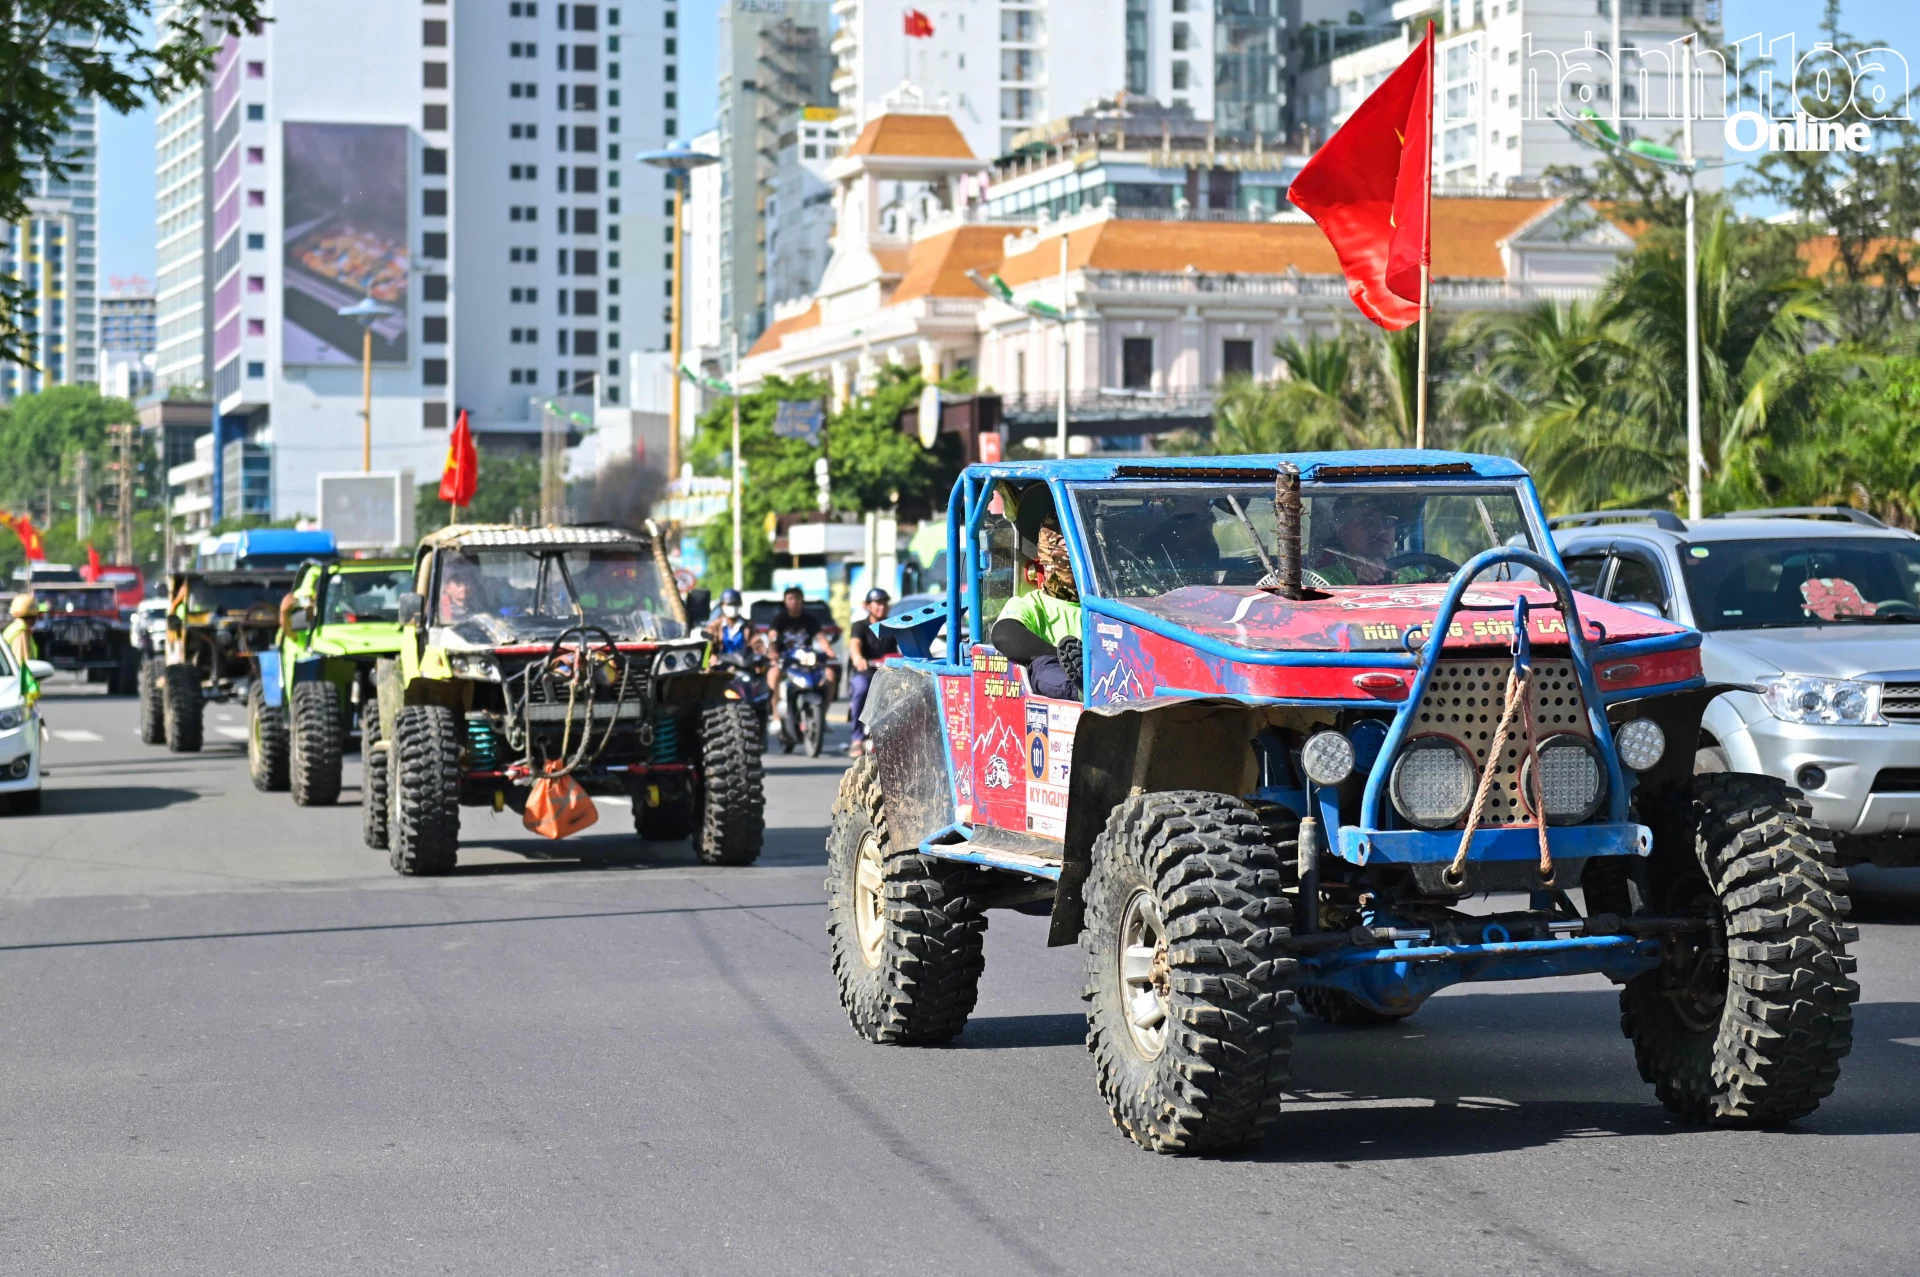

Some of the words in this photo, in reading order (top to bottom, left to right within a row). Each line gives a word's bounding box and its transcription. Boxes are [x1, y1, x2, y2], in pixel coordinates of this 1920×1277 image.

[1363, 621, 1398, 640] NÚI
[1406, 619, 1463, 639] HỒG
[1472, 618, 1529, 636] SÔN
[1536, 618, 1567, 634] LA
[973, 650, 986, 672] NÚI
[1032, 747, 1042, 768] 101
